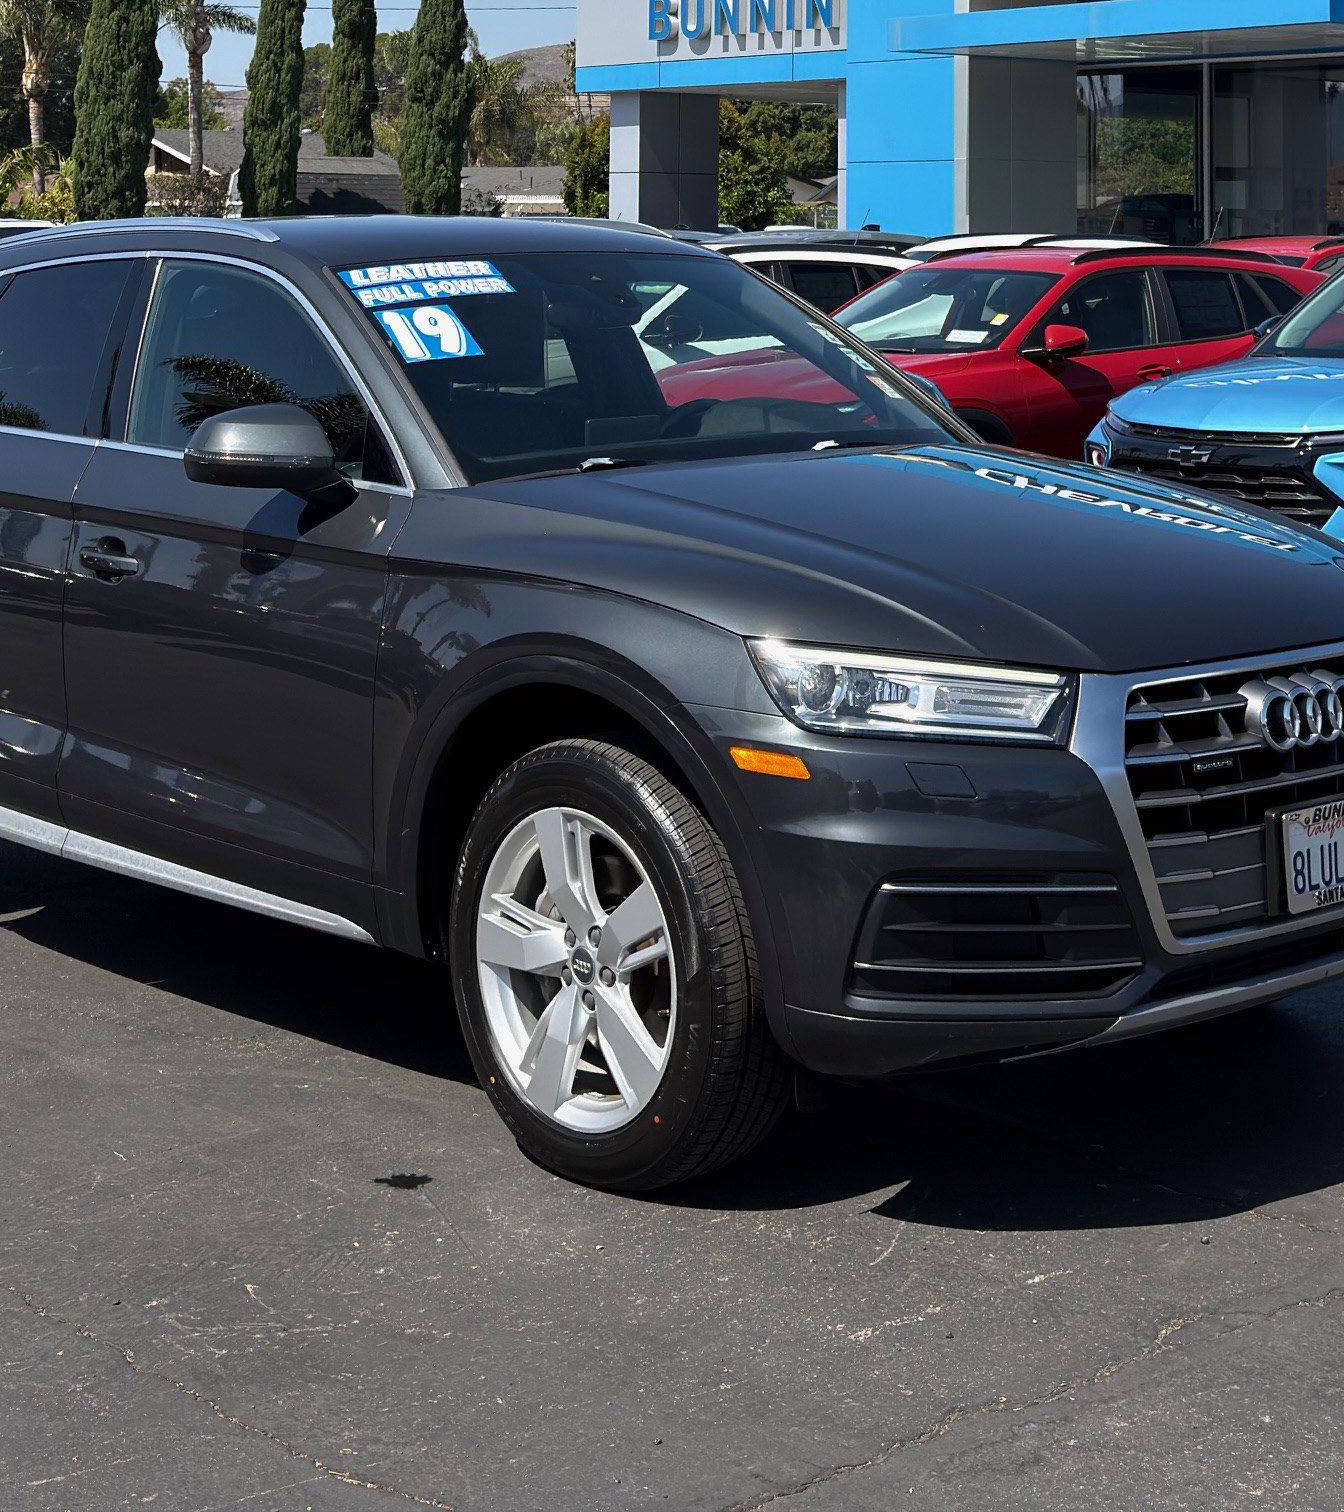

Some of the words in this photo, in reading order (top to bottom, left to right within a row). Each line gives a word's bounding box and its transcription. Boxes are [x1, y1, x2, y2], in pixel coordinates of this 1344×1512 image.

[349, 260, 492, 286] LEATHER
[359, 287, 425, 307] FULL
[422, 276, 509, 298] POWER
[382, 306, 467, 360] 19
